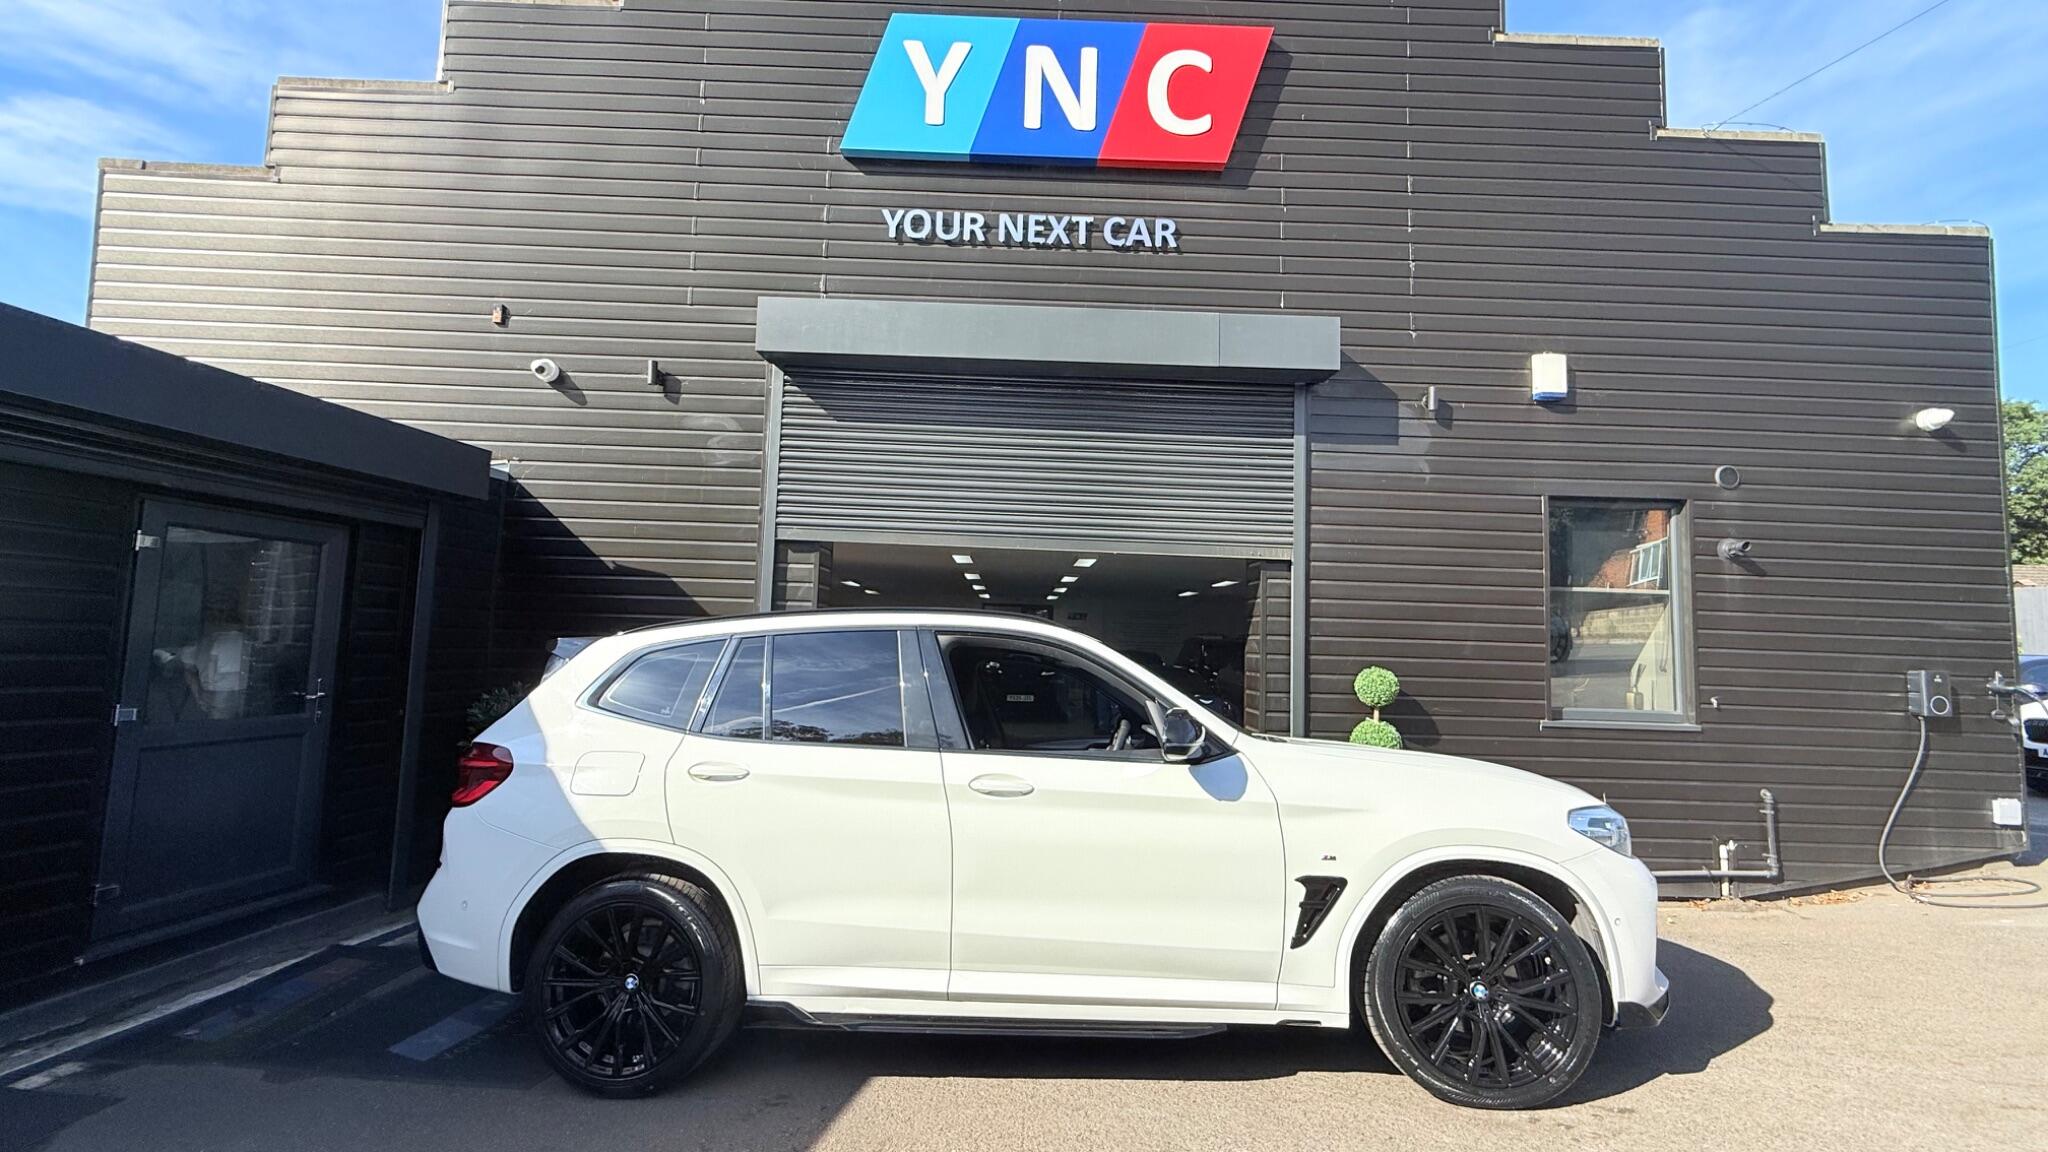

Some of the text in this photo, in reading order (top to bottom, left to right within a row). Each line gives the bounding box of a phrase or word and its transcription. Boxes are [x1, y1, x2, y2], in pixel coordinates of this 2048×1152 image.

[903, 39, 1213, 136] YNC
[881, 208, 1177, 248] YOUR NEXT CAR
